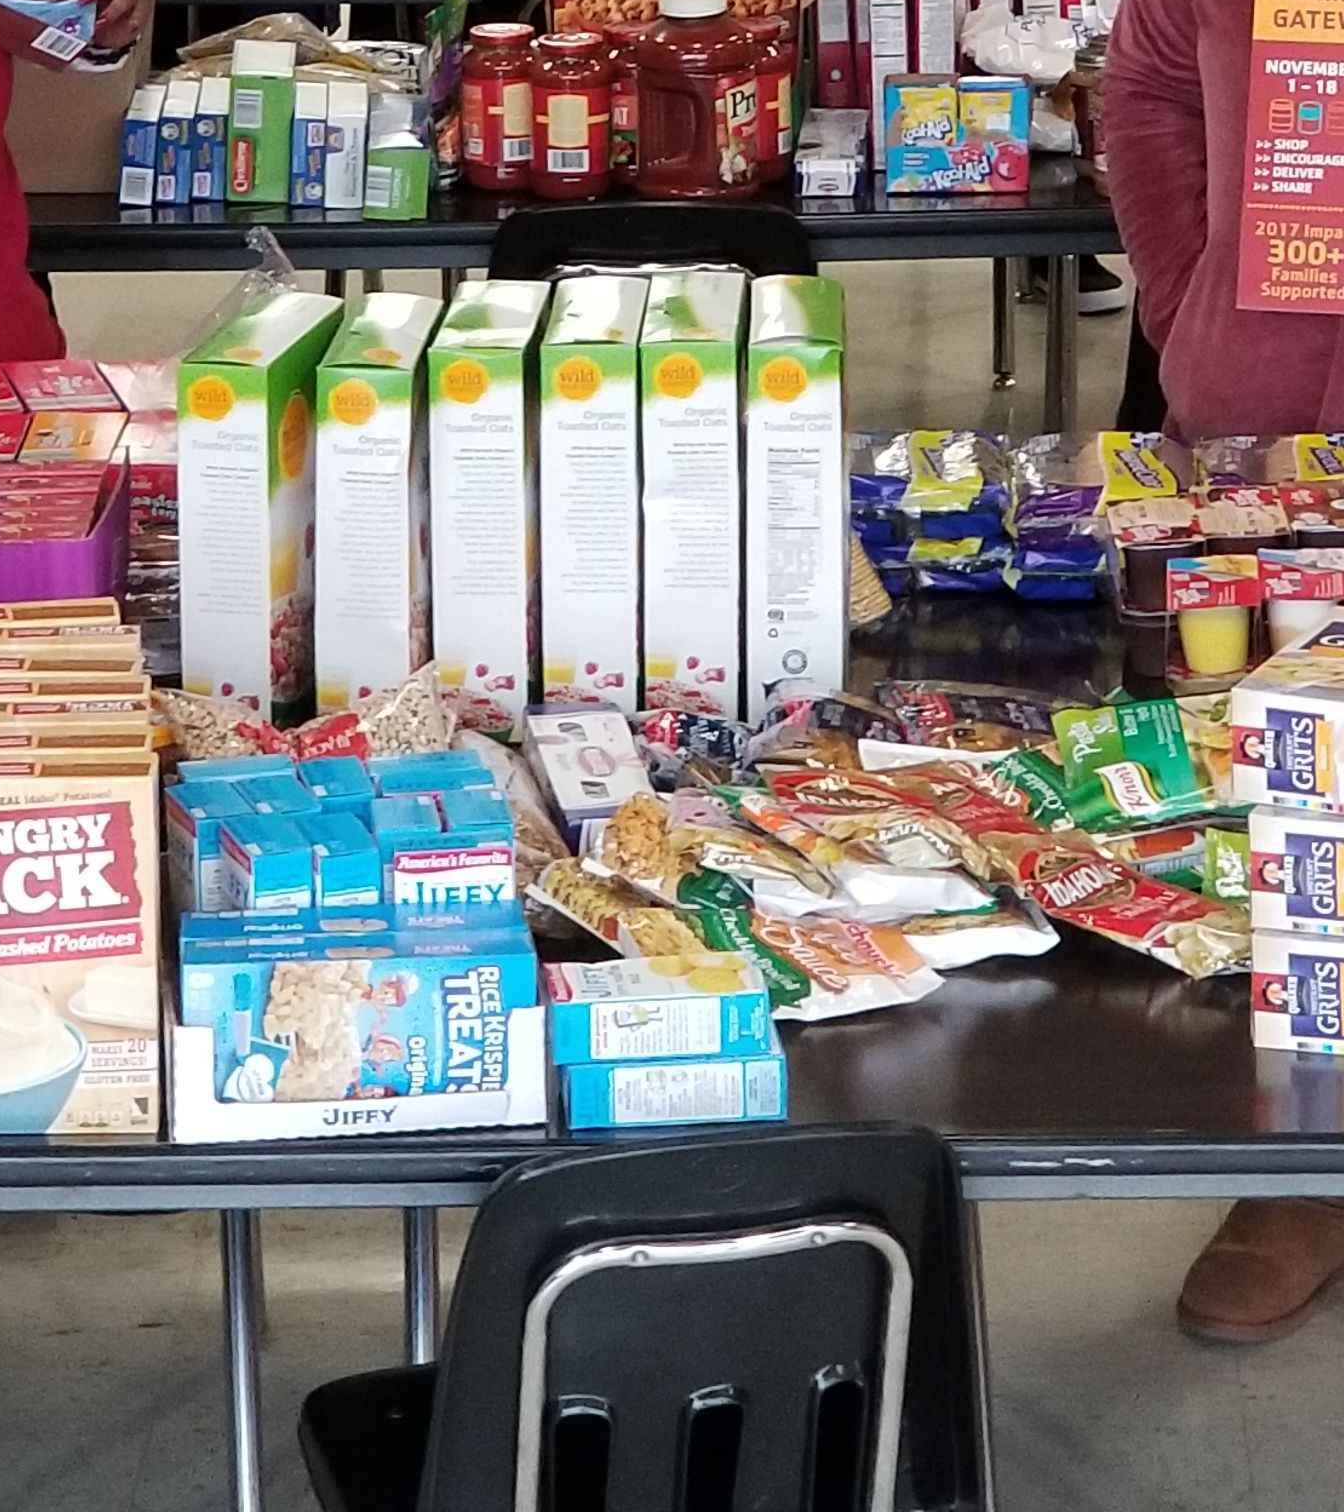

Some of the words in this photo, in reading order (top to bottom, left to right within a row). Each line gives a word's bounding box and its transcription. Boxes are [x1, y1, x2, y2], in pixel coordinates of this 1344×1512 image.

[1287, 79, 1297, 93] 1
[1316, 79, 1338, 95] 18
[1274, 138, 1309, 151] SHOP
[1273, 167, 1324, 180] DELIVER
[1271, 181, 1313, 194] SHARE
[1255, 220, 1301, 237] 2017
[1272, 267, 1338, 284] Families
[558, 369, 595, 385] wild
[659, 366, 696, 382] wild
[765, 369, 802, 385] wild
[1291, 717, 1315, 790] GRITS
[1114, 765, 1151, 812] Knorr
[1312, 841, 1336, 916] GRITS
[52, 931, 136, 955] Potatoes
[759, 925, 849, 990] Sauce
[477, 966, 502, 1014] RICE
[1316, 961, 1339, 1037] GRITS
[127, 1037, 147, 1054] 20
[322, 1104, 398, 1126] JIFFY
